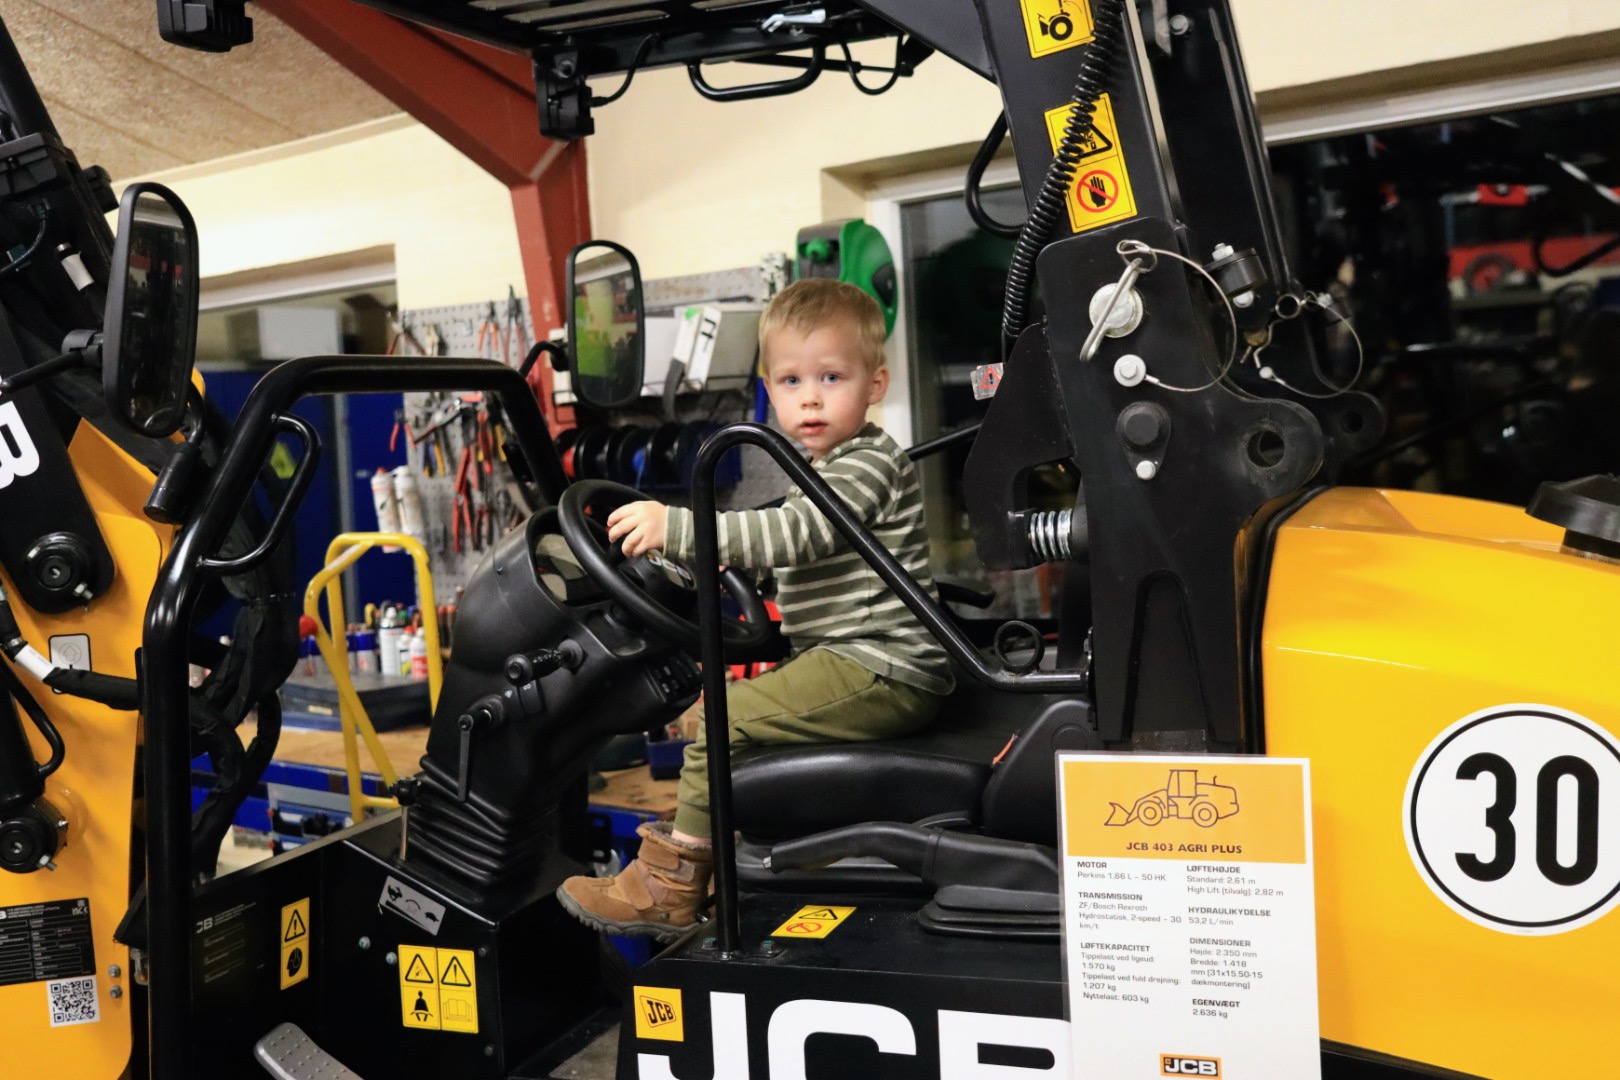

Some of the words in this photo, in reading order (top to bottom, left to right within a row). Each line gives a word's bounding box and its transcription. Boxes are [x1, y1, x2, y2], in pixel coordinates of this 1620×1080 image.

[1455, 752, 1599, 886] 30
[1126, 842, 1149, 851] JCB
[1152, 843, 1174, 852] 403
[1178, 844, 1208, 853] AGRI
[1211, 844, 1242, 854] PLUS
[1077, 861, 1107, 869] MOTOR
[1186, 865, 1241, 873] LØFTEHØJDE
[1077, 871, 1106, 879] Perkins
[1141, 873, 1153, 881] 50
[1186, 875, 1225, 884] Standard:
[1187, 886, 1205, 895] High
[1206, 886, 1220, 894] Lift
[1078, 891, 1143, 901] TRANSMISSION
[1078, 901, 1117, 910] ZF/Bosch
[1117, 903, 1148, 911] Rexroth
[1188, 906, 1271, 917] HYDRAULIKYDELSE
[1131, 914, 1161, 922] 2-speed
[1170, 915, 1182, 923] 30
[1080, 942, 1150, 952] LØFTEKAPACITET
[1189, 937, 1251, 947] DIMENSIONER
[1081, 952, 1115, 961] Tippelast
[1190, 957, 1220, 966] Bredde:
[1106, 964, 1116, 972] kg
[1082, 972, 1116, 981] Tippelast
[1107, 983, 1117, 992] kg
[1083, 991, 1121, 1001] Nyttelast:
[1121, 994, 1139, 1002] 603
[1140, 995, 1149, 1004] kg
[1192, 998, 1240, 1008] EGENVÆGT
[646, 999, 674, 1024] JCB
[1192, 1008, 1217, 1017] 2.636
[1218, 1010, 1228, 1019] kg
[1164, 1057, 1218, 1077] JCB
